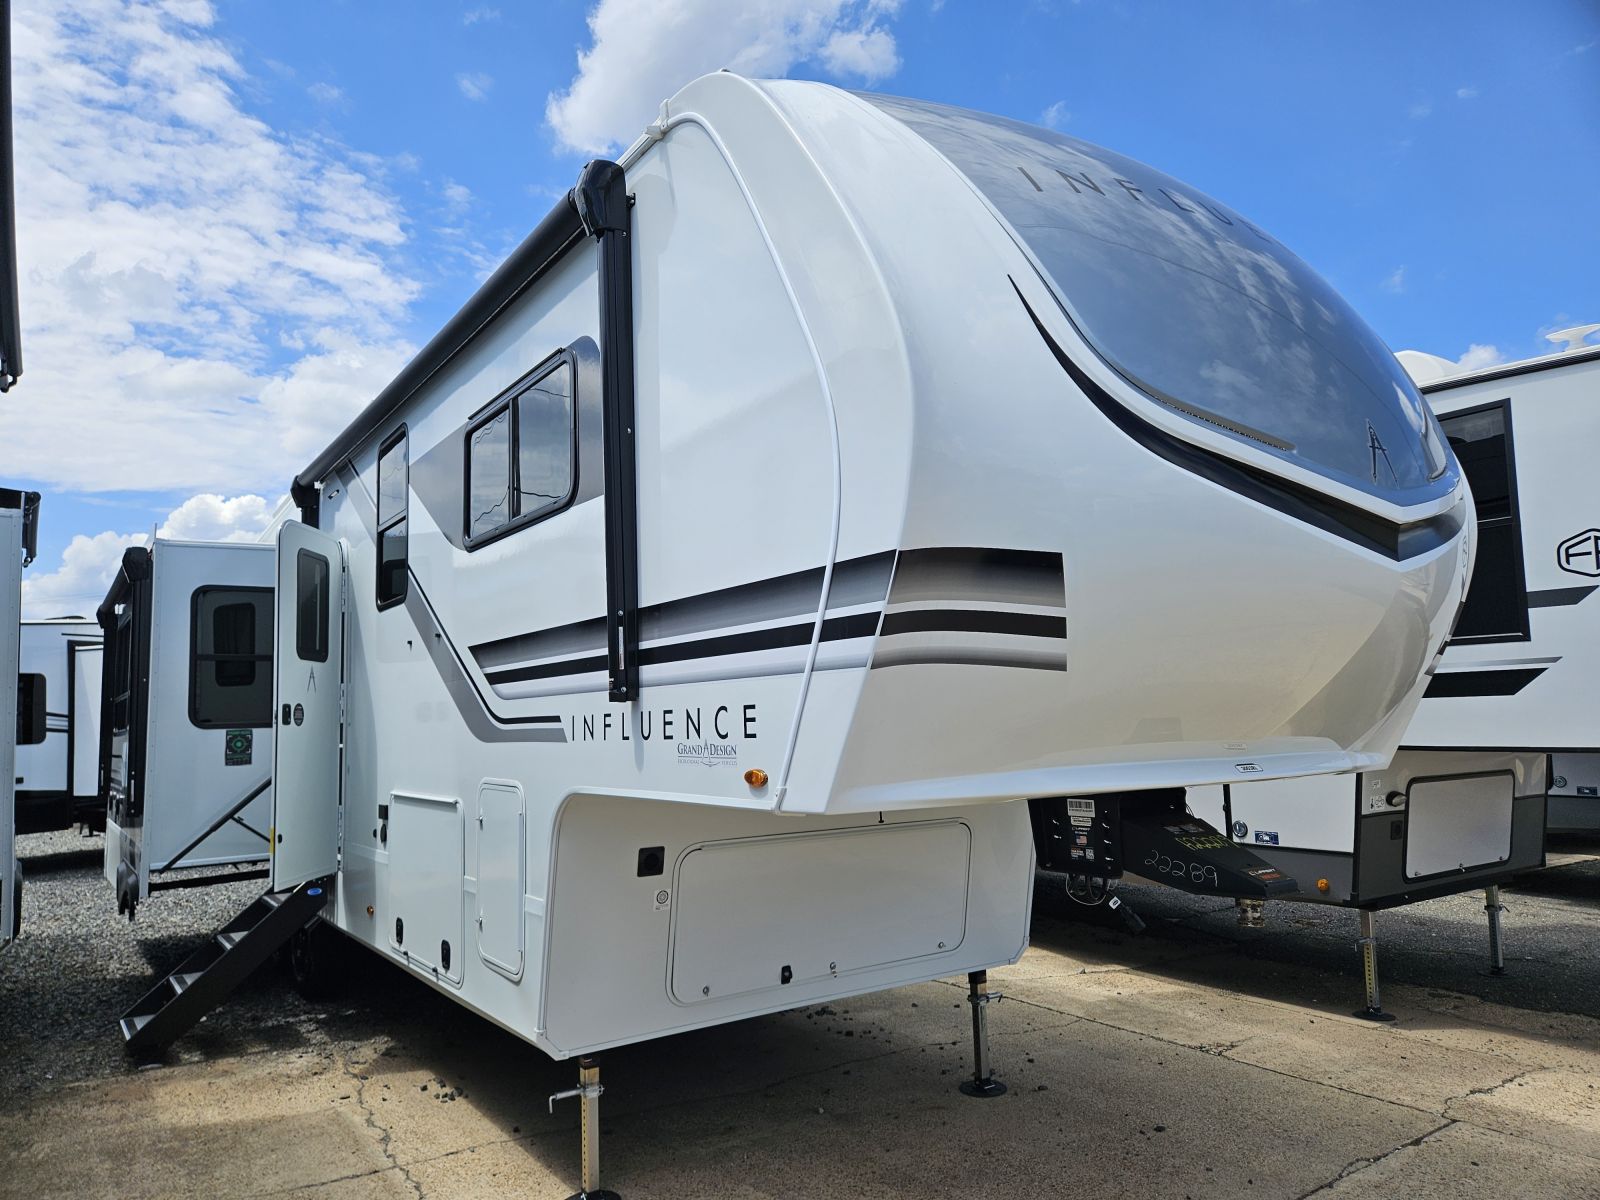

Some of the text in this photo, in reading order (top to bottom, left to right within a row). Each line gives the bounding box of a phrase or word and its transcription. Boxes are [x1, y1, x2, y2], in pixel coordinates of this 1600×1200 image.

[571, 704, 758, 742] INFLUENCE
[677, 742, 738, 756] GRAND DESIGN
[1144, 849, 1218, 888] 22289
